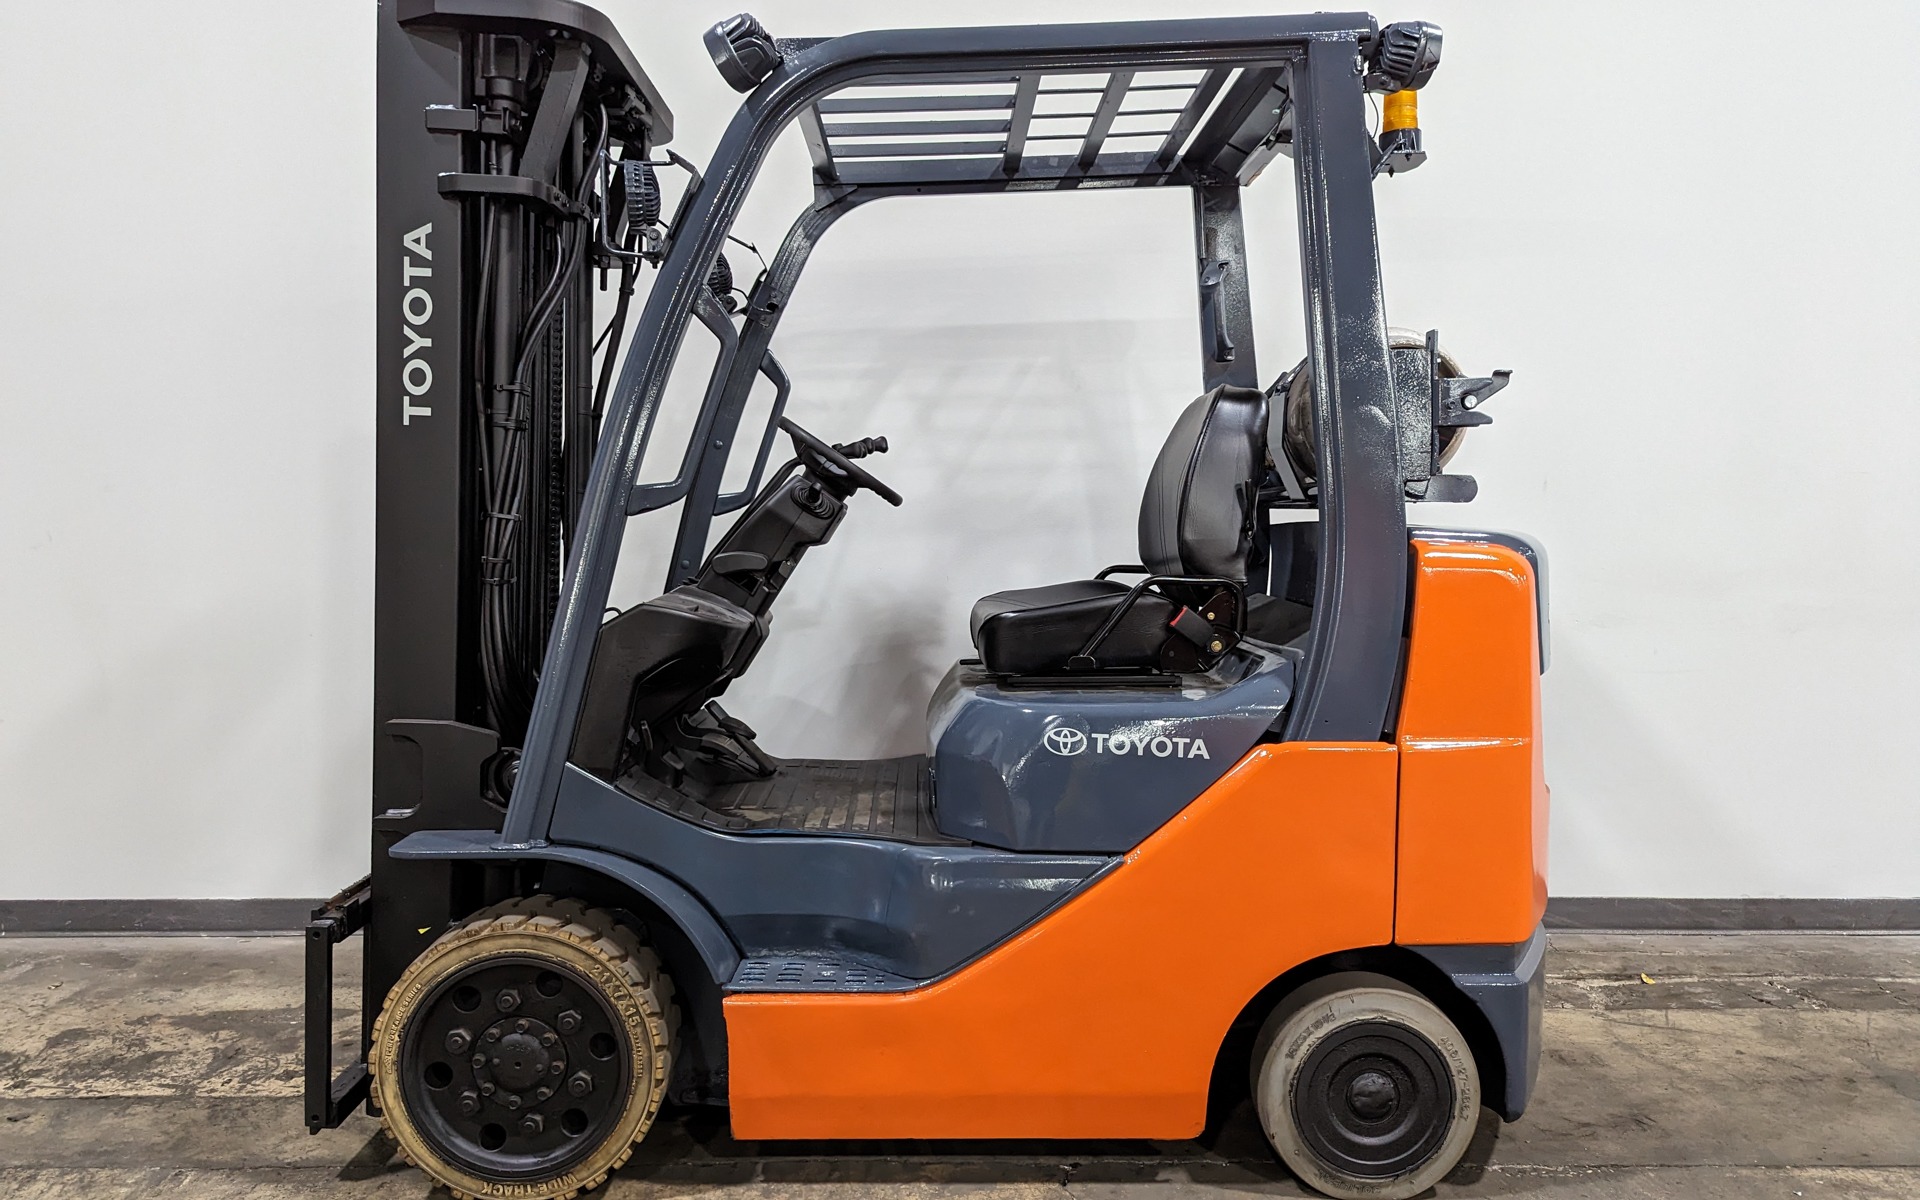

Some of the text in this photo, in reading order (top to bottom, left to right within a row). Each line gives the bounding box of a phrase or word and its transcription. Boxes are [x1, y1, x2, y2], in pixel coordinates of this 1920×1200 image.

[403, 222, 433, 425] TOYOTA
[1091, 733, 1210, 760] TOYOTA
[481, 1172, 578, 1197] WIDE TRACK
